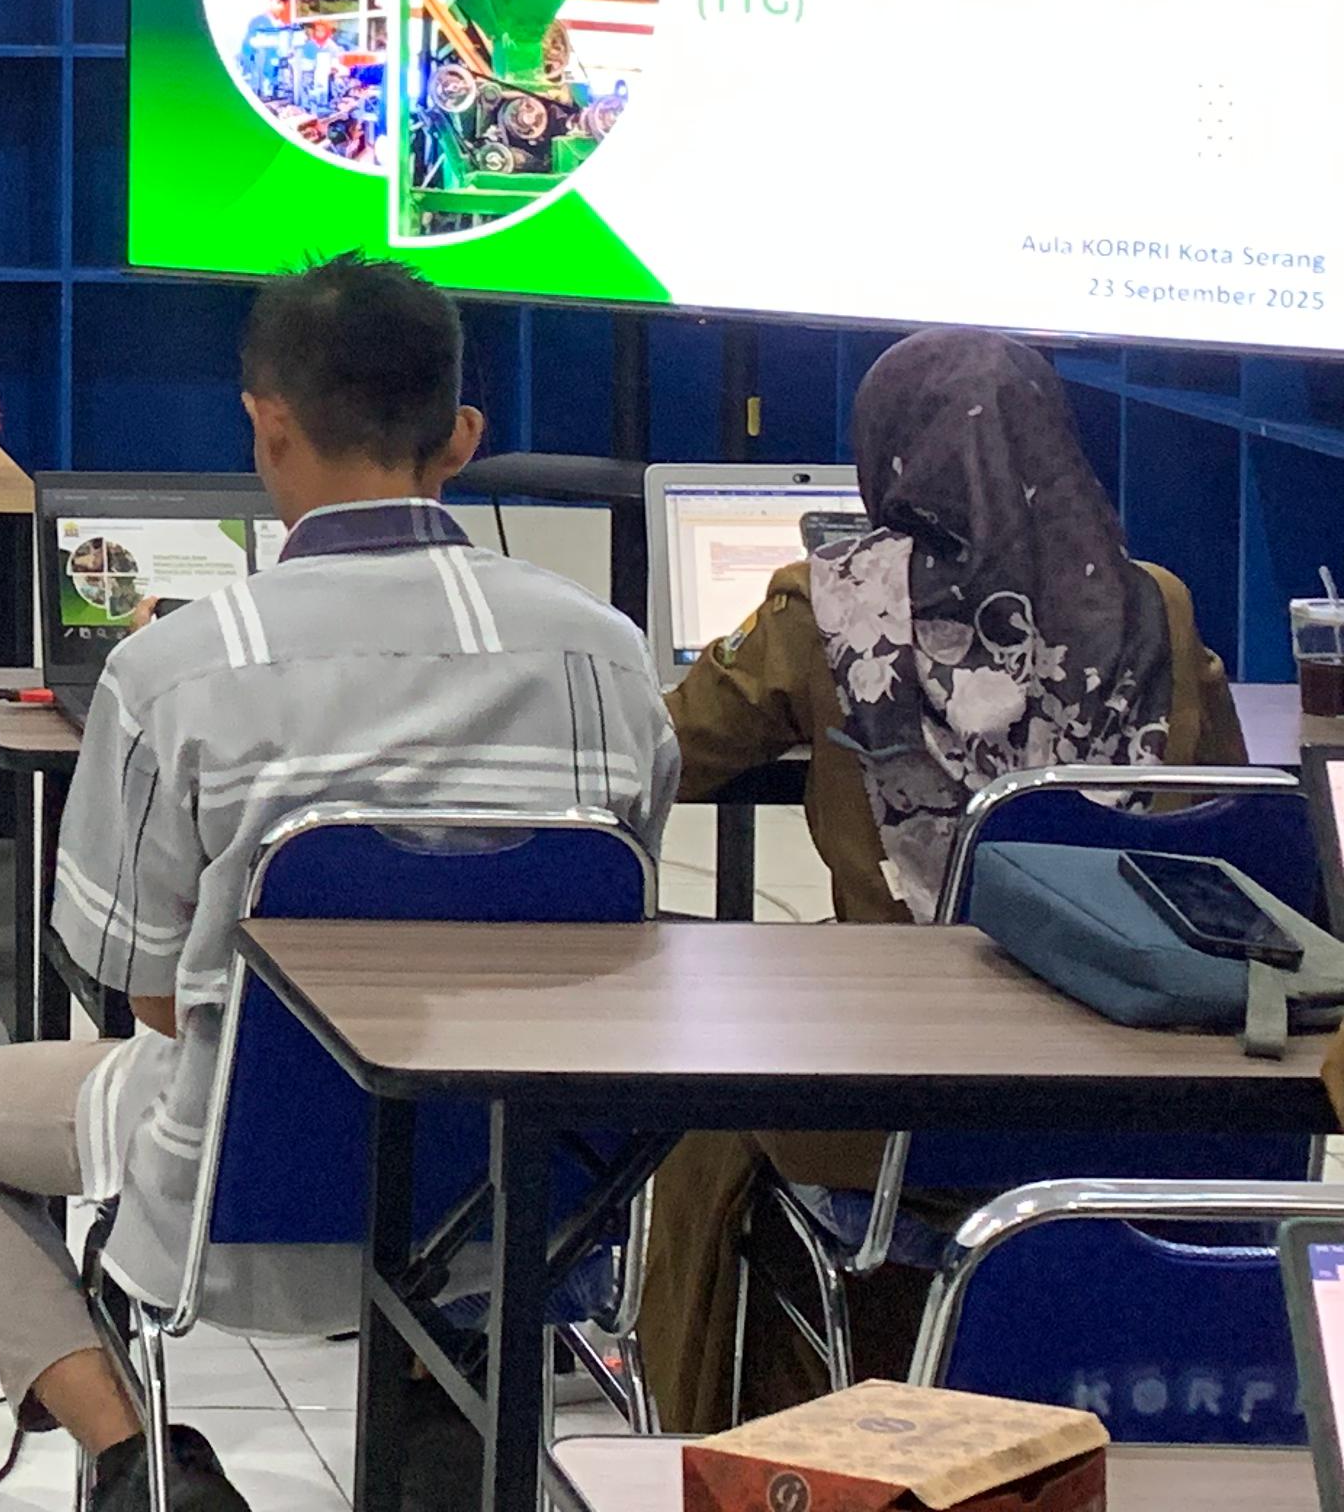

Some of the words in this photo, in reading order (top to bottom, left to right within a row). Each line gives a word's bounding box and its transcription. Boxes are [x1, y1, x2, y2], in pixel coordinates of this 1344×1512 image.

[1022, 235, 1073, 255] Aula
[1082, 239, 1170, 260] KORPRI
[1179, 243, 1233, 264] Kota
[1242, 246, 1326, 274] Serang
[1087, 277, 1115, 297] 23
[1123, 280, 1256, 306] September
[1265, 288, 1325, 311] 2025
[1069, 1368, 1304, 1423] KORP
